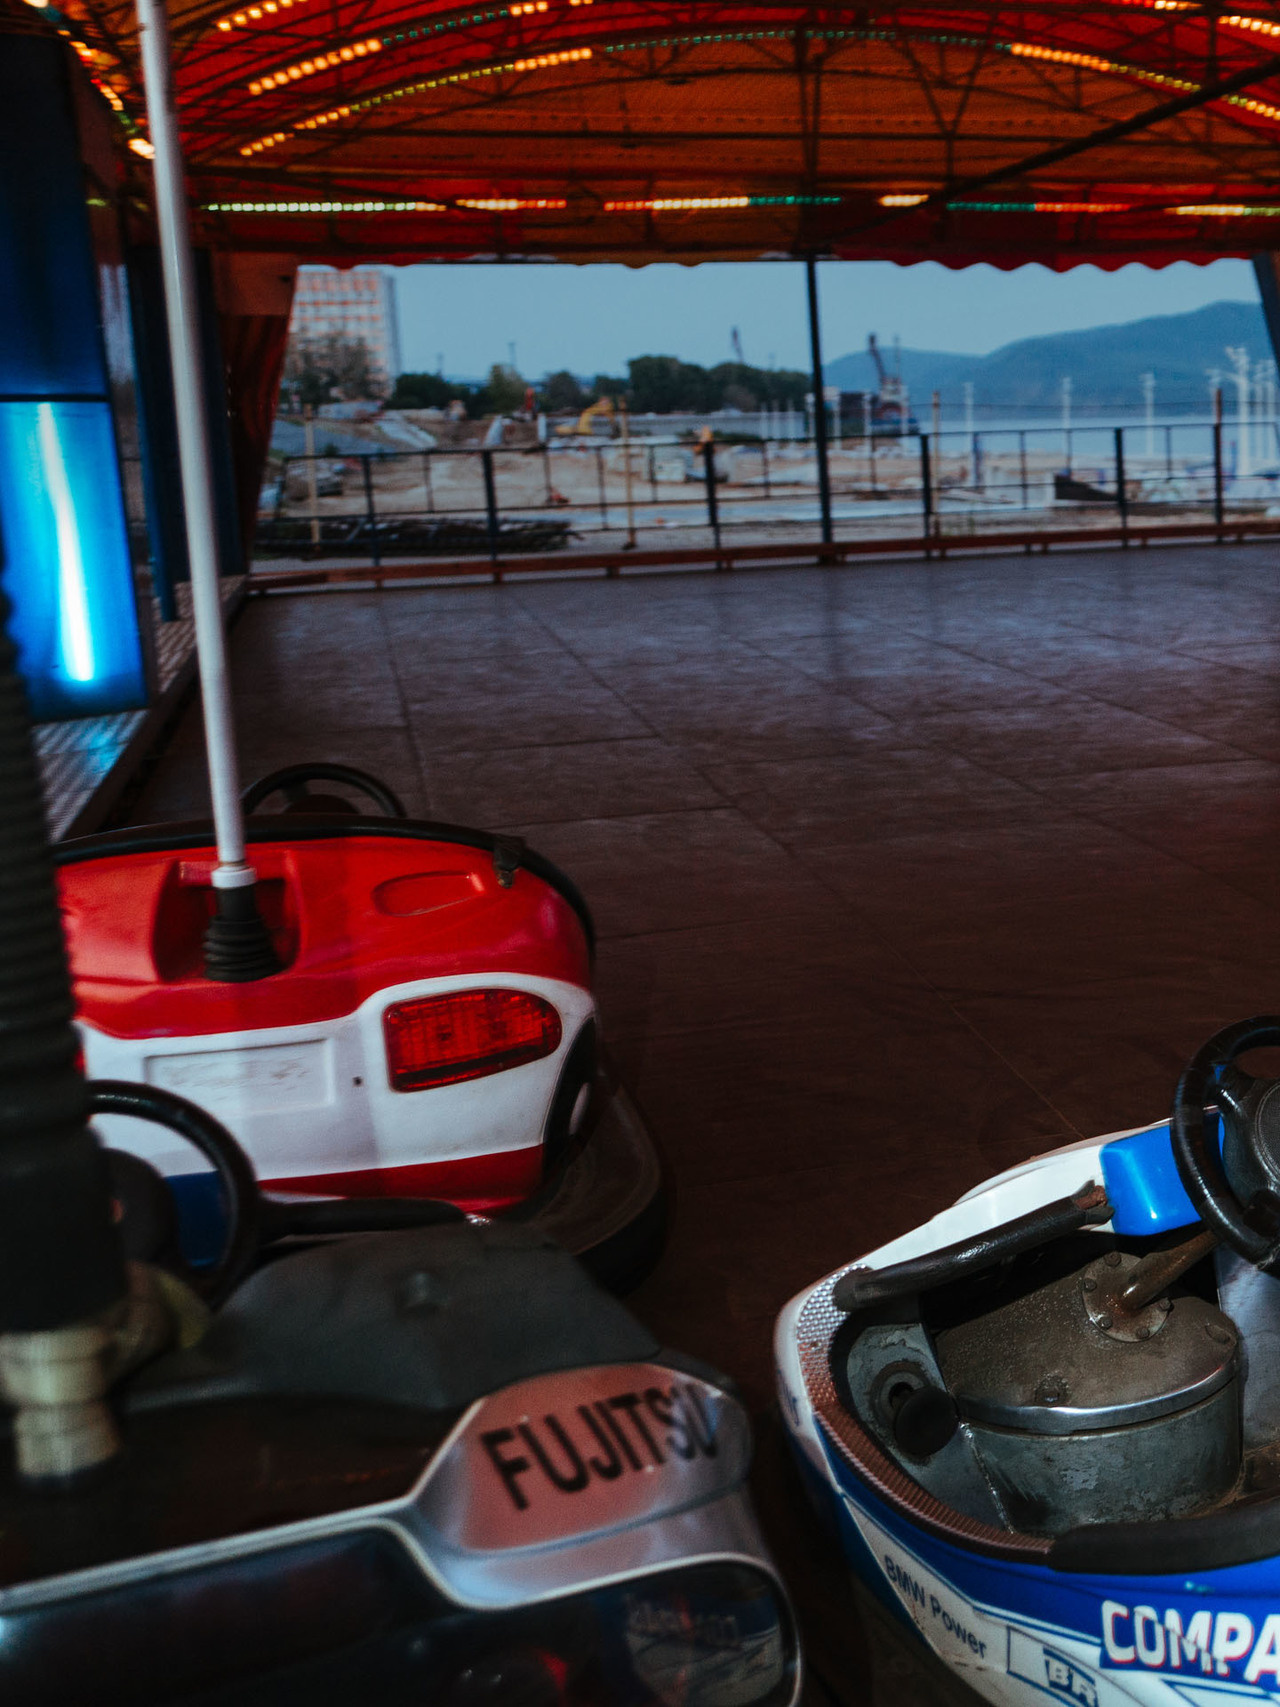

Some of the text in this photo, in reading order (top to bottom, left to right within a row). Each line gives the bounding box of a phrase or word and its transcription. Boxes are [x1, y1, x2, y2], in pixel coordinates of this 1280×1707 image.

[482, 1382, 721, 1511] FUJITSU
[884, 1554, 987, 1660] BMW Power
